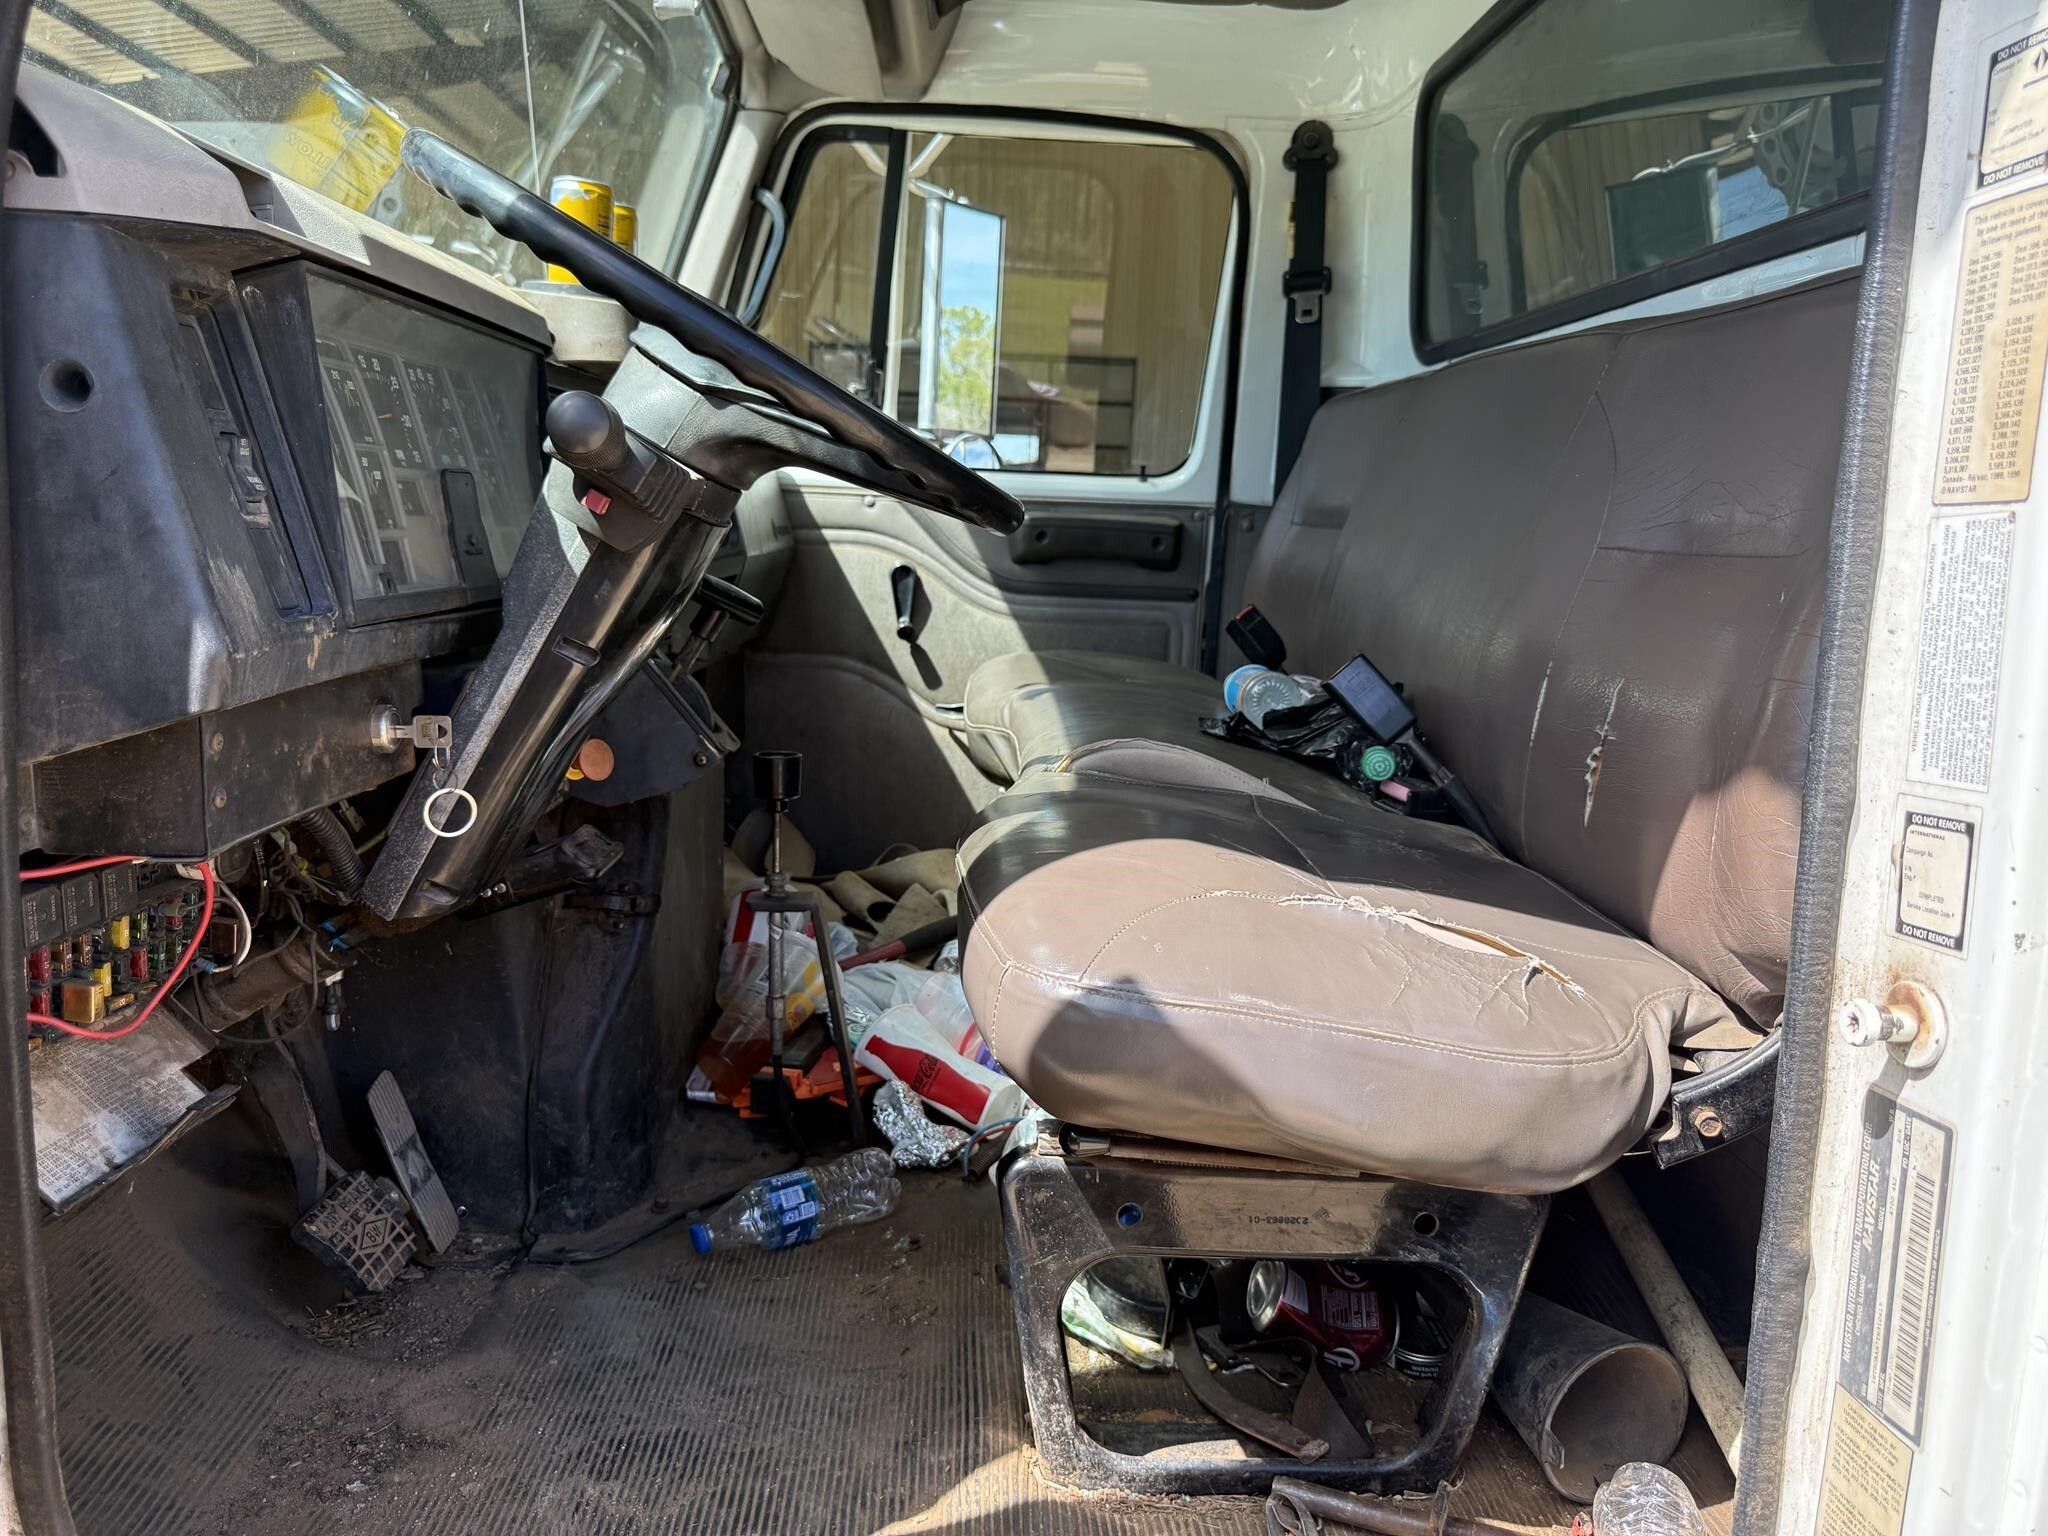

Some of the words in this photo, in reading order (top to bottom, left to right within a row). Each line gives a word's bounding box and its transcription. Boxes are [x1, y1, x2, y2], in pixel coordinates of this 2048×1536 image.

[1984, 174, 1995, 185] DO
[1996, 166, 2012, 180] NOT
[2013, 155, 2045, 174] REMOVE
[1912, 814, 1922, 824] DO
[1923, 816, 1937, 826] NOT
[1938, 819, 1966, 832] REMOVE
[1902, 925, 1912, 934] DO
[1914, 928, 1926, 938] NOT
[1928, 932, 1955, 948] REMOVE
[1854, 1150, 1870, 1237] TRANSPORTATION
[1860, 1158, 1880, 1254] NAVISTAR
[1847, 1239, 1861, 1315] INTERNATIONAL
[1842, 1312, 1854, 1363] NAVISTAR
